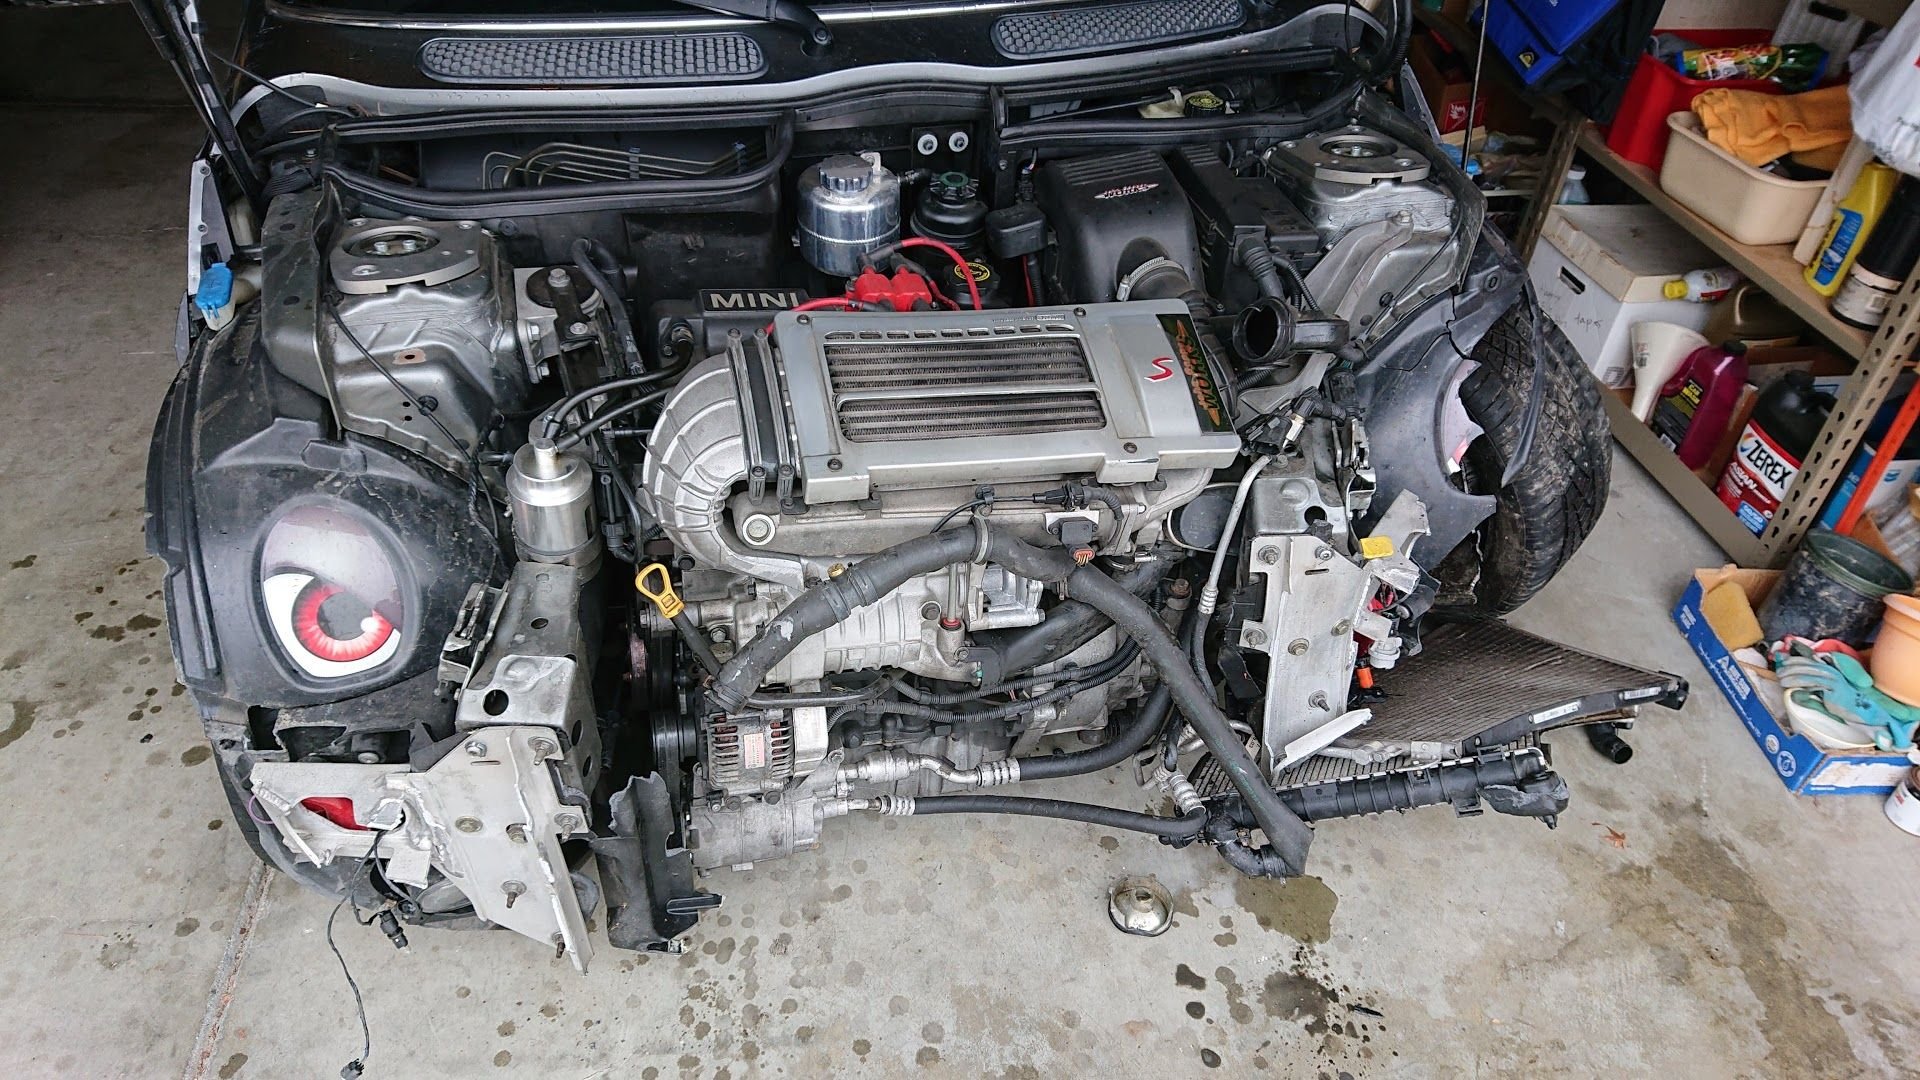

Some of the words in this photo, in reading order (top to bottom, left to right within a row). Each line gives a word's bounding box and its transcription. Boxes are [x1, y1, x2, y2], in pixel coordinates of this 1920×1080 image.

[710, 292, 800, 308] MINI
[1144, 357, 1174, 382] S
[1728, 461, 1757, 490] ASIAN
[1746, 439, 1792, 489] ZEREX
